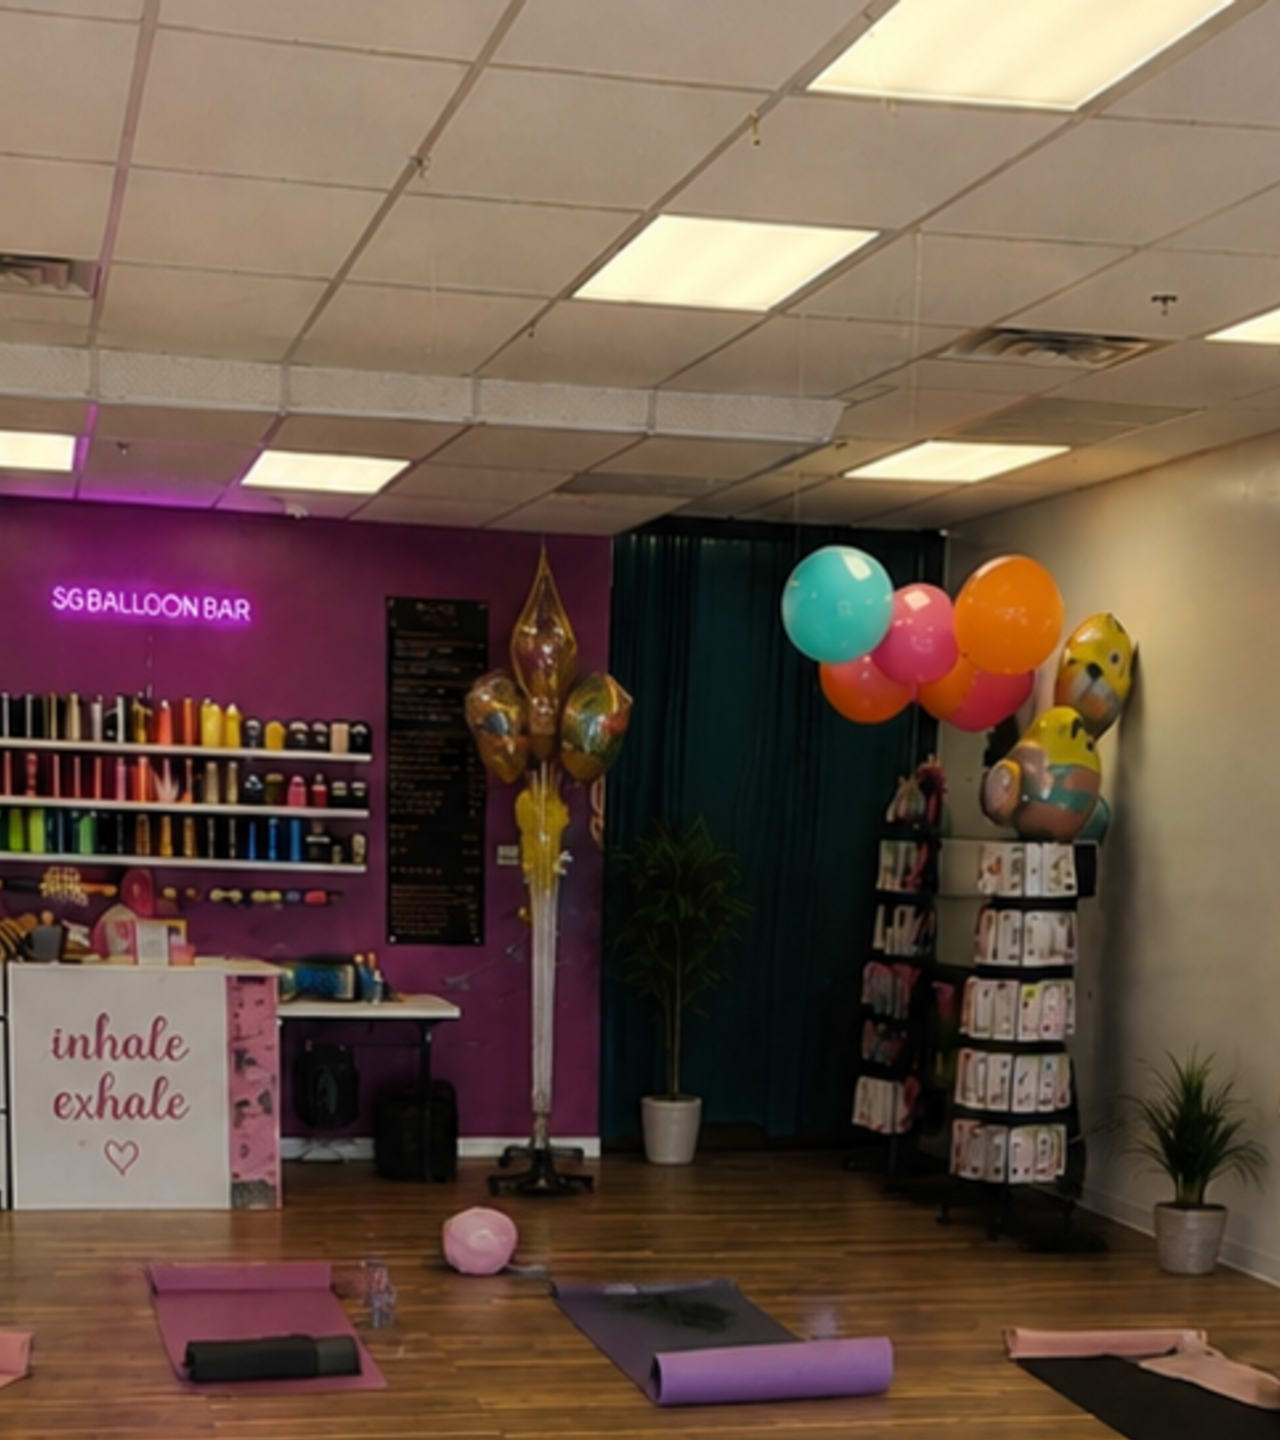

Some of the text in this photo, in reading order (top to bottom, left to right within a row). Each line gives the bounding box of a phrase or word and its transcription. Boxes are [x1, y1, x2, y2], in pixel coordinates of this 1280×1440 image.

[202, 596, 252, 622] BAR
[51, 1011, 190, 1062] inhale
[53, 1070, 190, 1121] exhale
